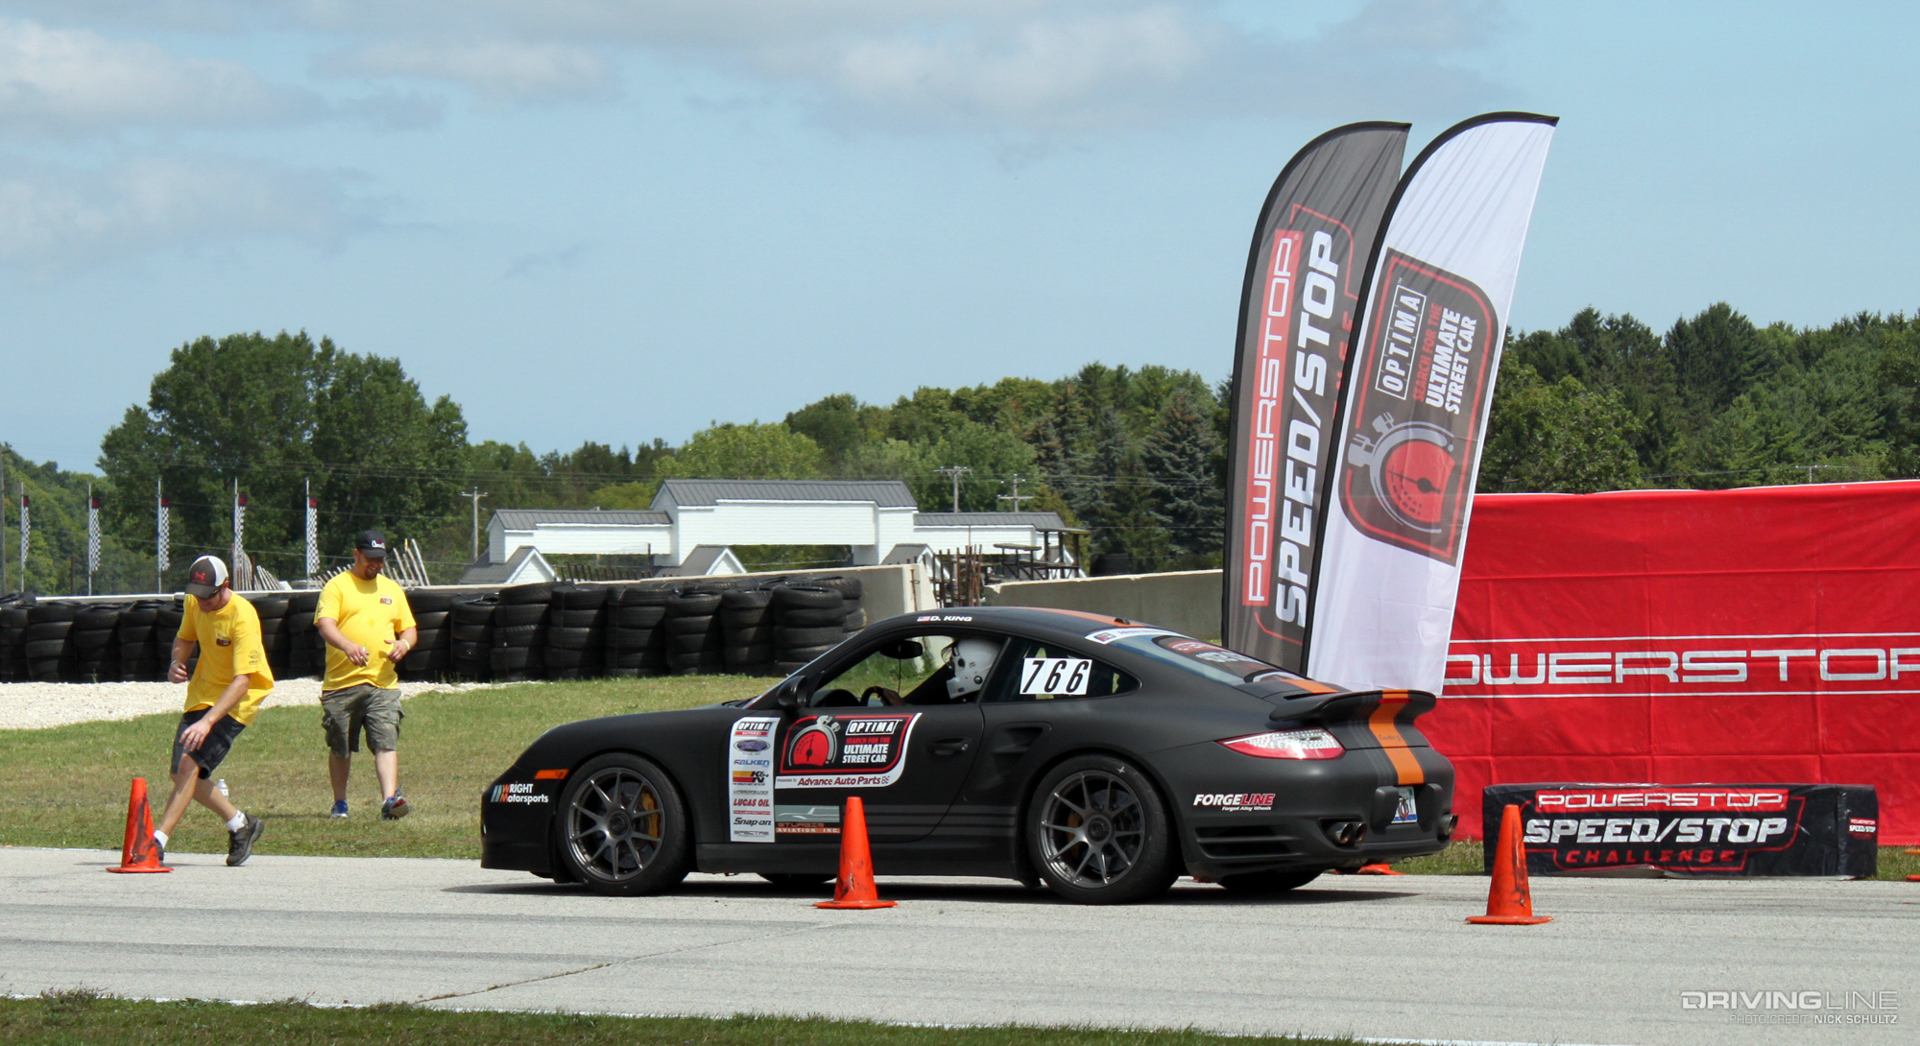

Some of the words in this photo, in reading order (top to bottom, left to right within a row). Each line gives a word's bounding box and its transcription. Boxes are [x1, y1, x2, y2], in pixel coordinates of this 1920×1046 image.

[1427, 302, 1443, 327] THE
[1382, 294, 1421, 393] OPTIMA
[1422, 328, 1437, 354] FOR
[1456, 315, 1477, 352] CAR
[1425, 307, 1461, 408] ULTIMATE
[1413, 354, 1431, 403] SEARCH
[1444, 352, 1469, 415] STREET
[1248, 237, 1293, 602] POWERSTOP
[1276, 230, 1339, 628] SPEED/STOP
[1022, 659, 1090, 693] 766
[738, 722, 772, 731] OPTIMA
[848, 721, 895, 733] OPTIMA
[842, 754, 870, 763] STREET
[870, 754, 887, 763] CAR
[843, 744, 889, 754] ULTIMATE
[797, 777, 833, 786] Advance
[833, 776, 857, 785] Auto
[857, 776, 881, 785] Parts
[500, 794, 549, 806] Motorsports
[733, 799, 757, 807] LUCAS
[758, 799, 770, 807] OIL
[1193, 793, 1276, 806] FORGELINE
[1538, 792, 1784, 808] POWERSTOP
[1522, 817, 1788, 844] SPEED/STOP
[1564, 850, 1737, 864] CHALLENGE
